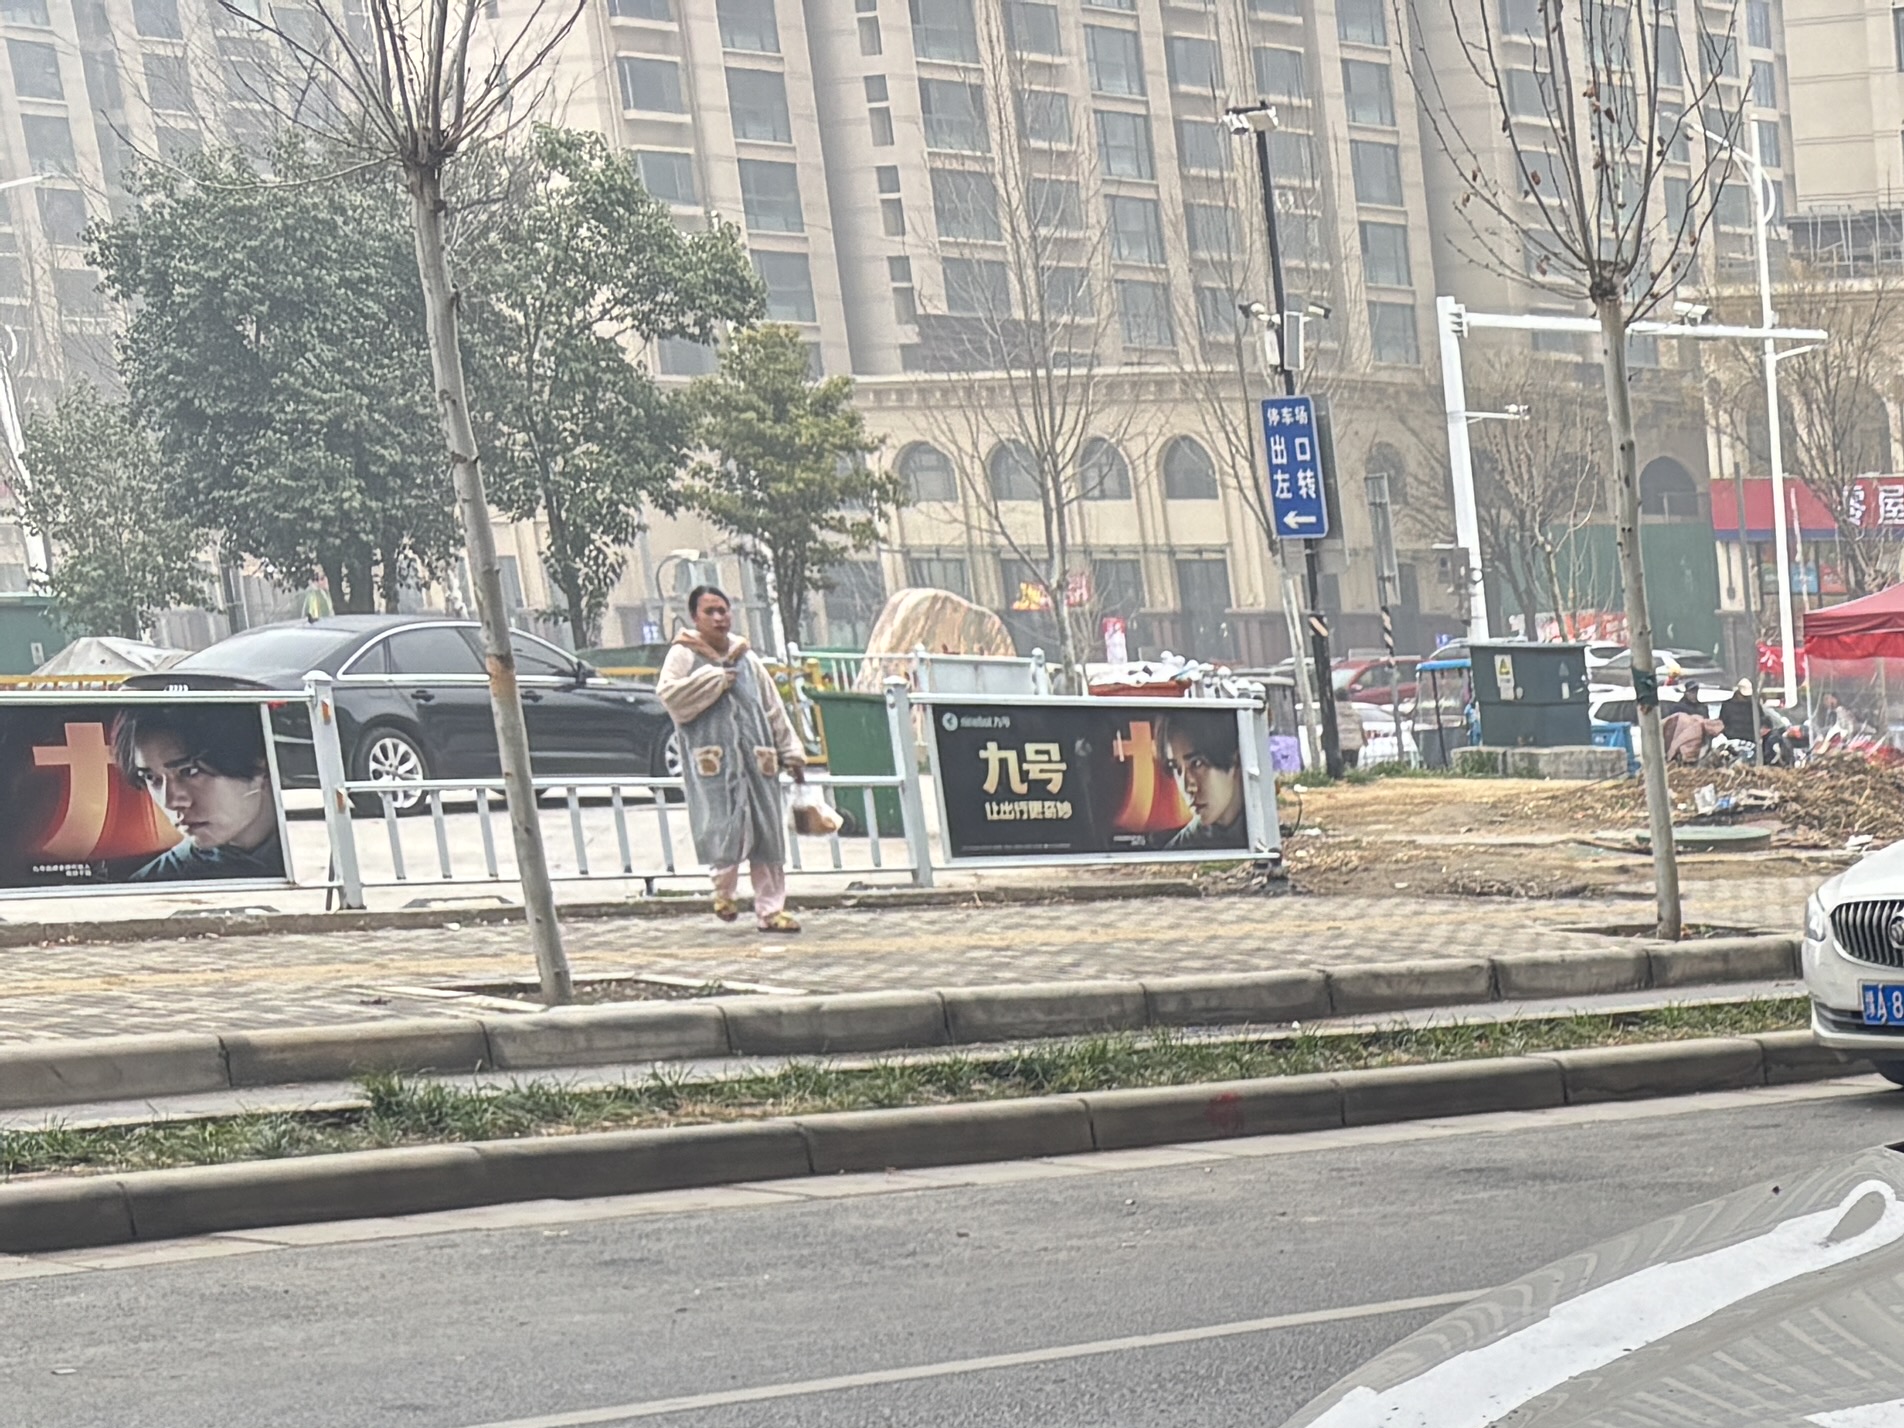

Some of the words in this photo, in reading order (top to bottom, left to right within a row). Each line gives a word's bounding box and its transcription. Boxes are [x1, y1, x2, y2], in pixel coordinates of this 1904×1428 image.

[1267, 405, 1309, 427] 停车场
[1270, 434, 1312, 465] 出口
[1273, 468, 1317, 500] 左转
[978, 741, 1067, 795] 九号
